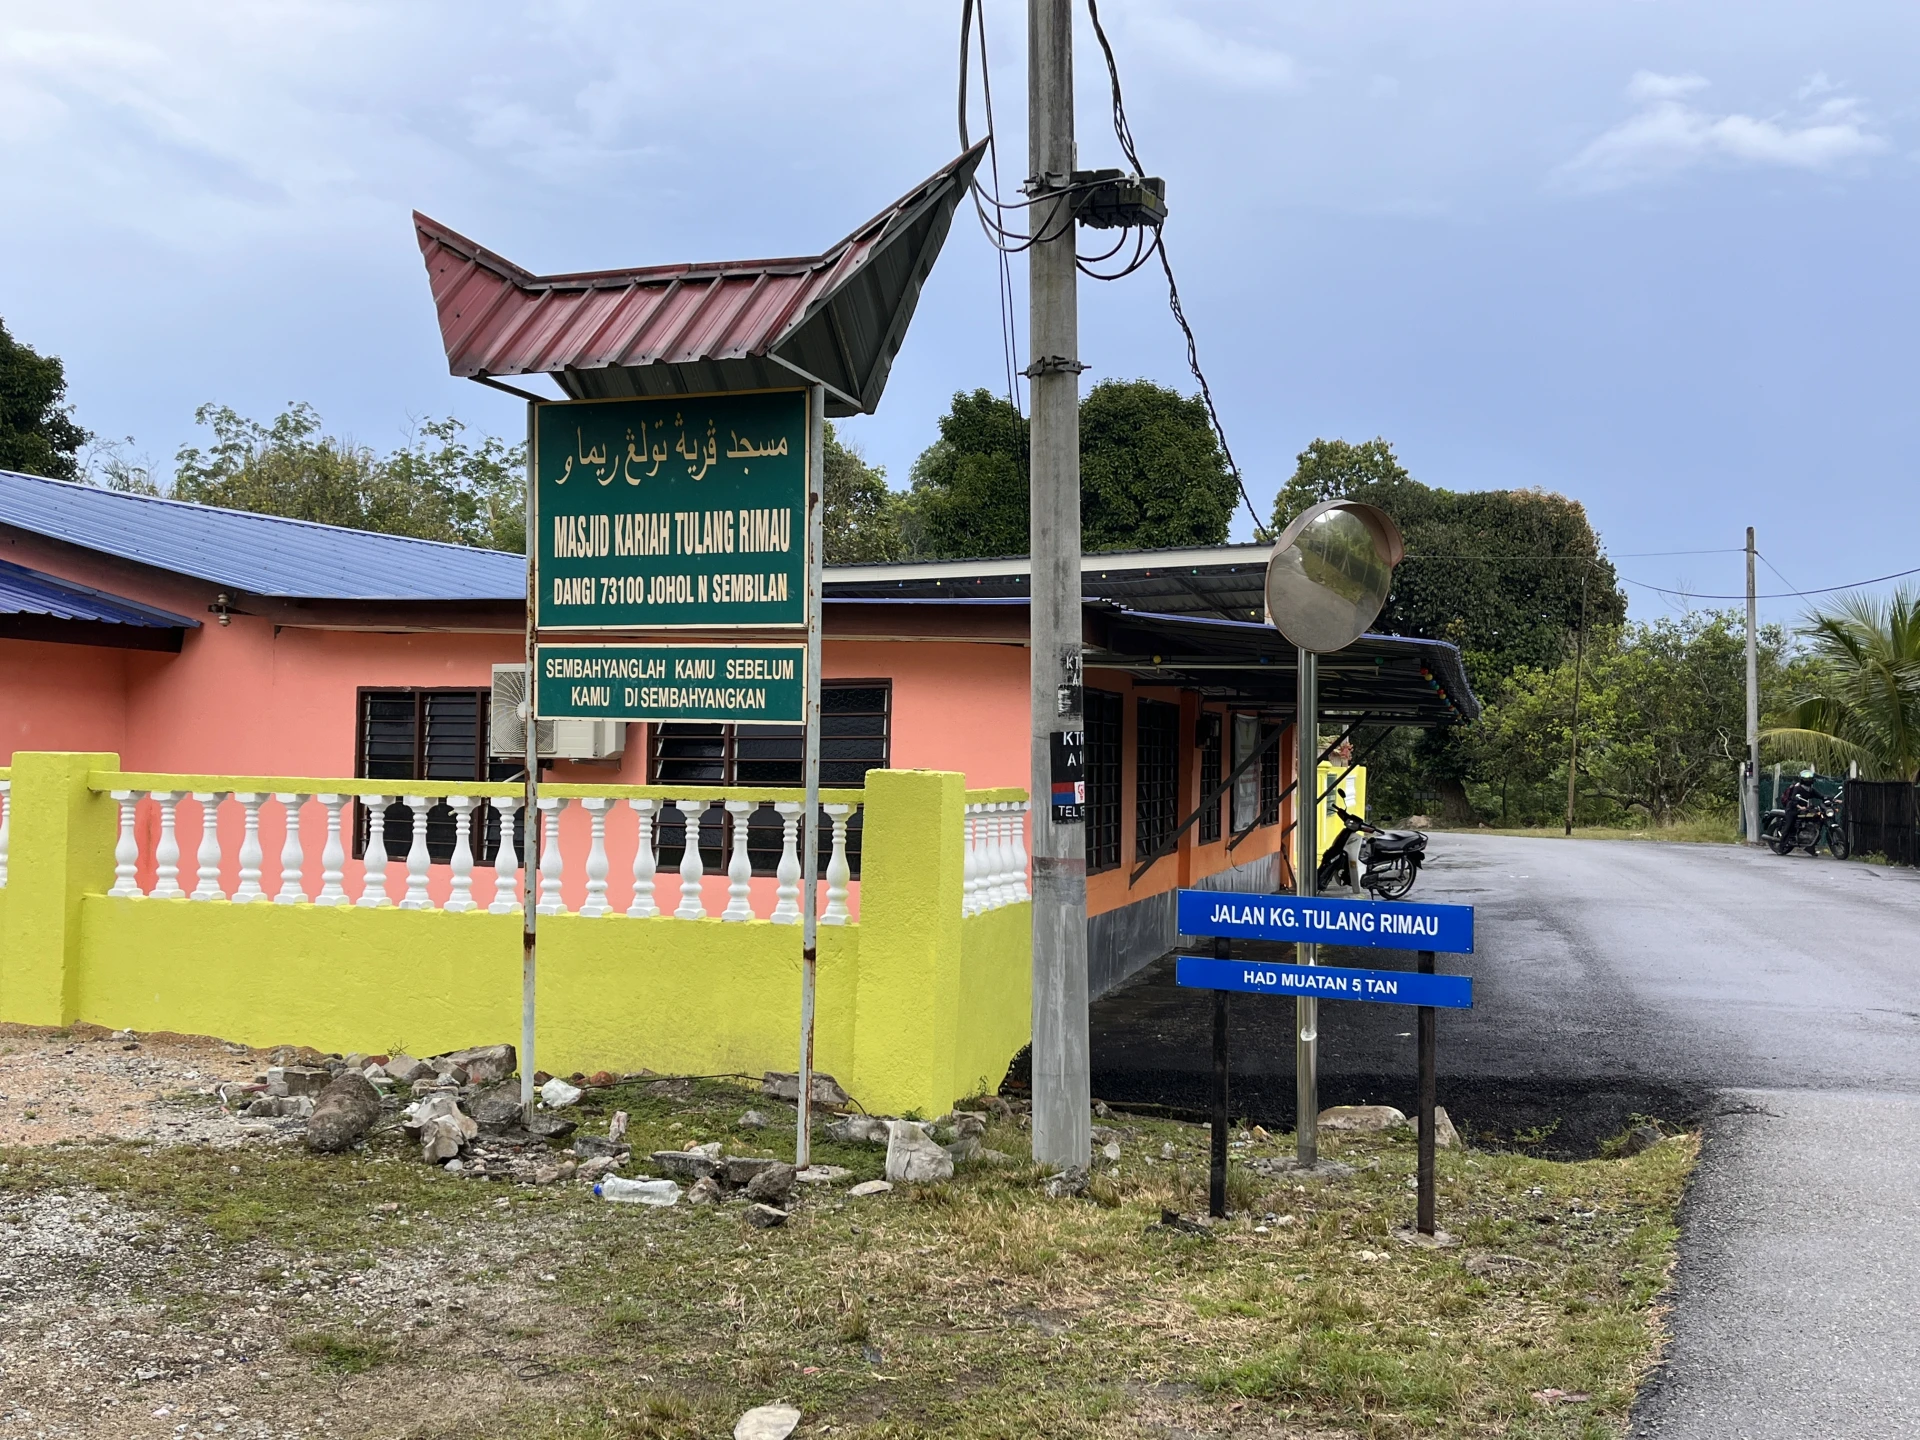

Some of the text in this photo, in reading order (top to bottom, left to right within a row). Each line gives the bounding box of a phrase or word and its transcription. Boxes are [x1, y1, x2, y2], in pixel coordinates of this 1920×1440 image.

[726, 429, 788, 475] مسجد
[555, 508, 790, 558] MASJID KARIAH TULANG RIMAU
[554, 573, 787, 605] DANGI 73100 JOHOL N SEMBILAN
[546, 659, 793, 679] SEMBAHYANGLAH KAMU SEBELUM
[572, 686, 610, 706] KAMU
[1058, 805, 1078, 817] TEL
[1211, 905, 1438, 935] JALAN KG. TULANG RIMAU
[1244, 971, 1397, 994] HAD MUATAN 5 TAN
